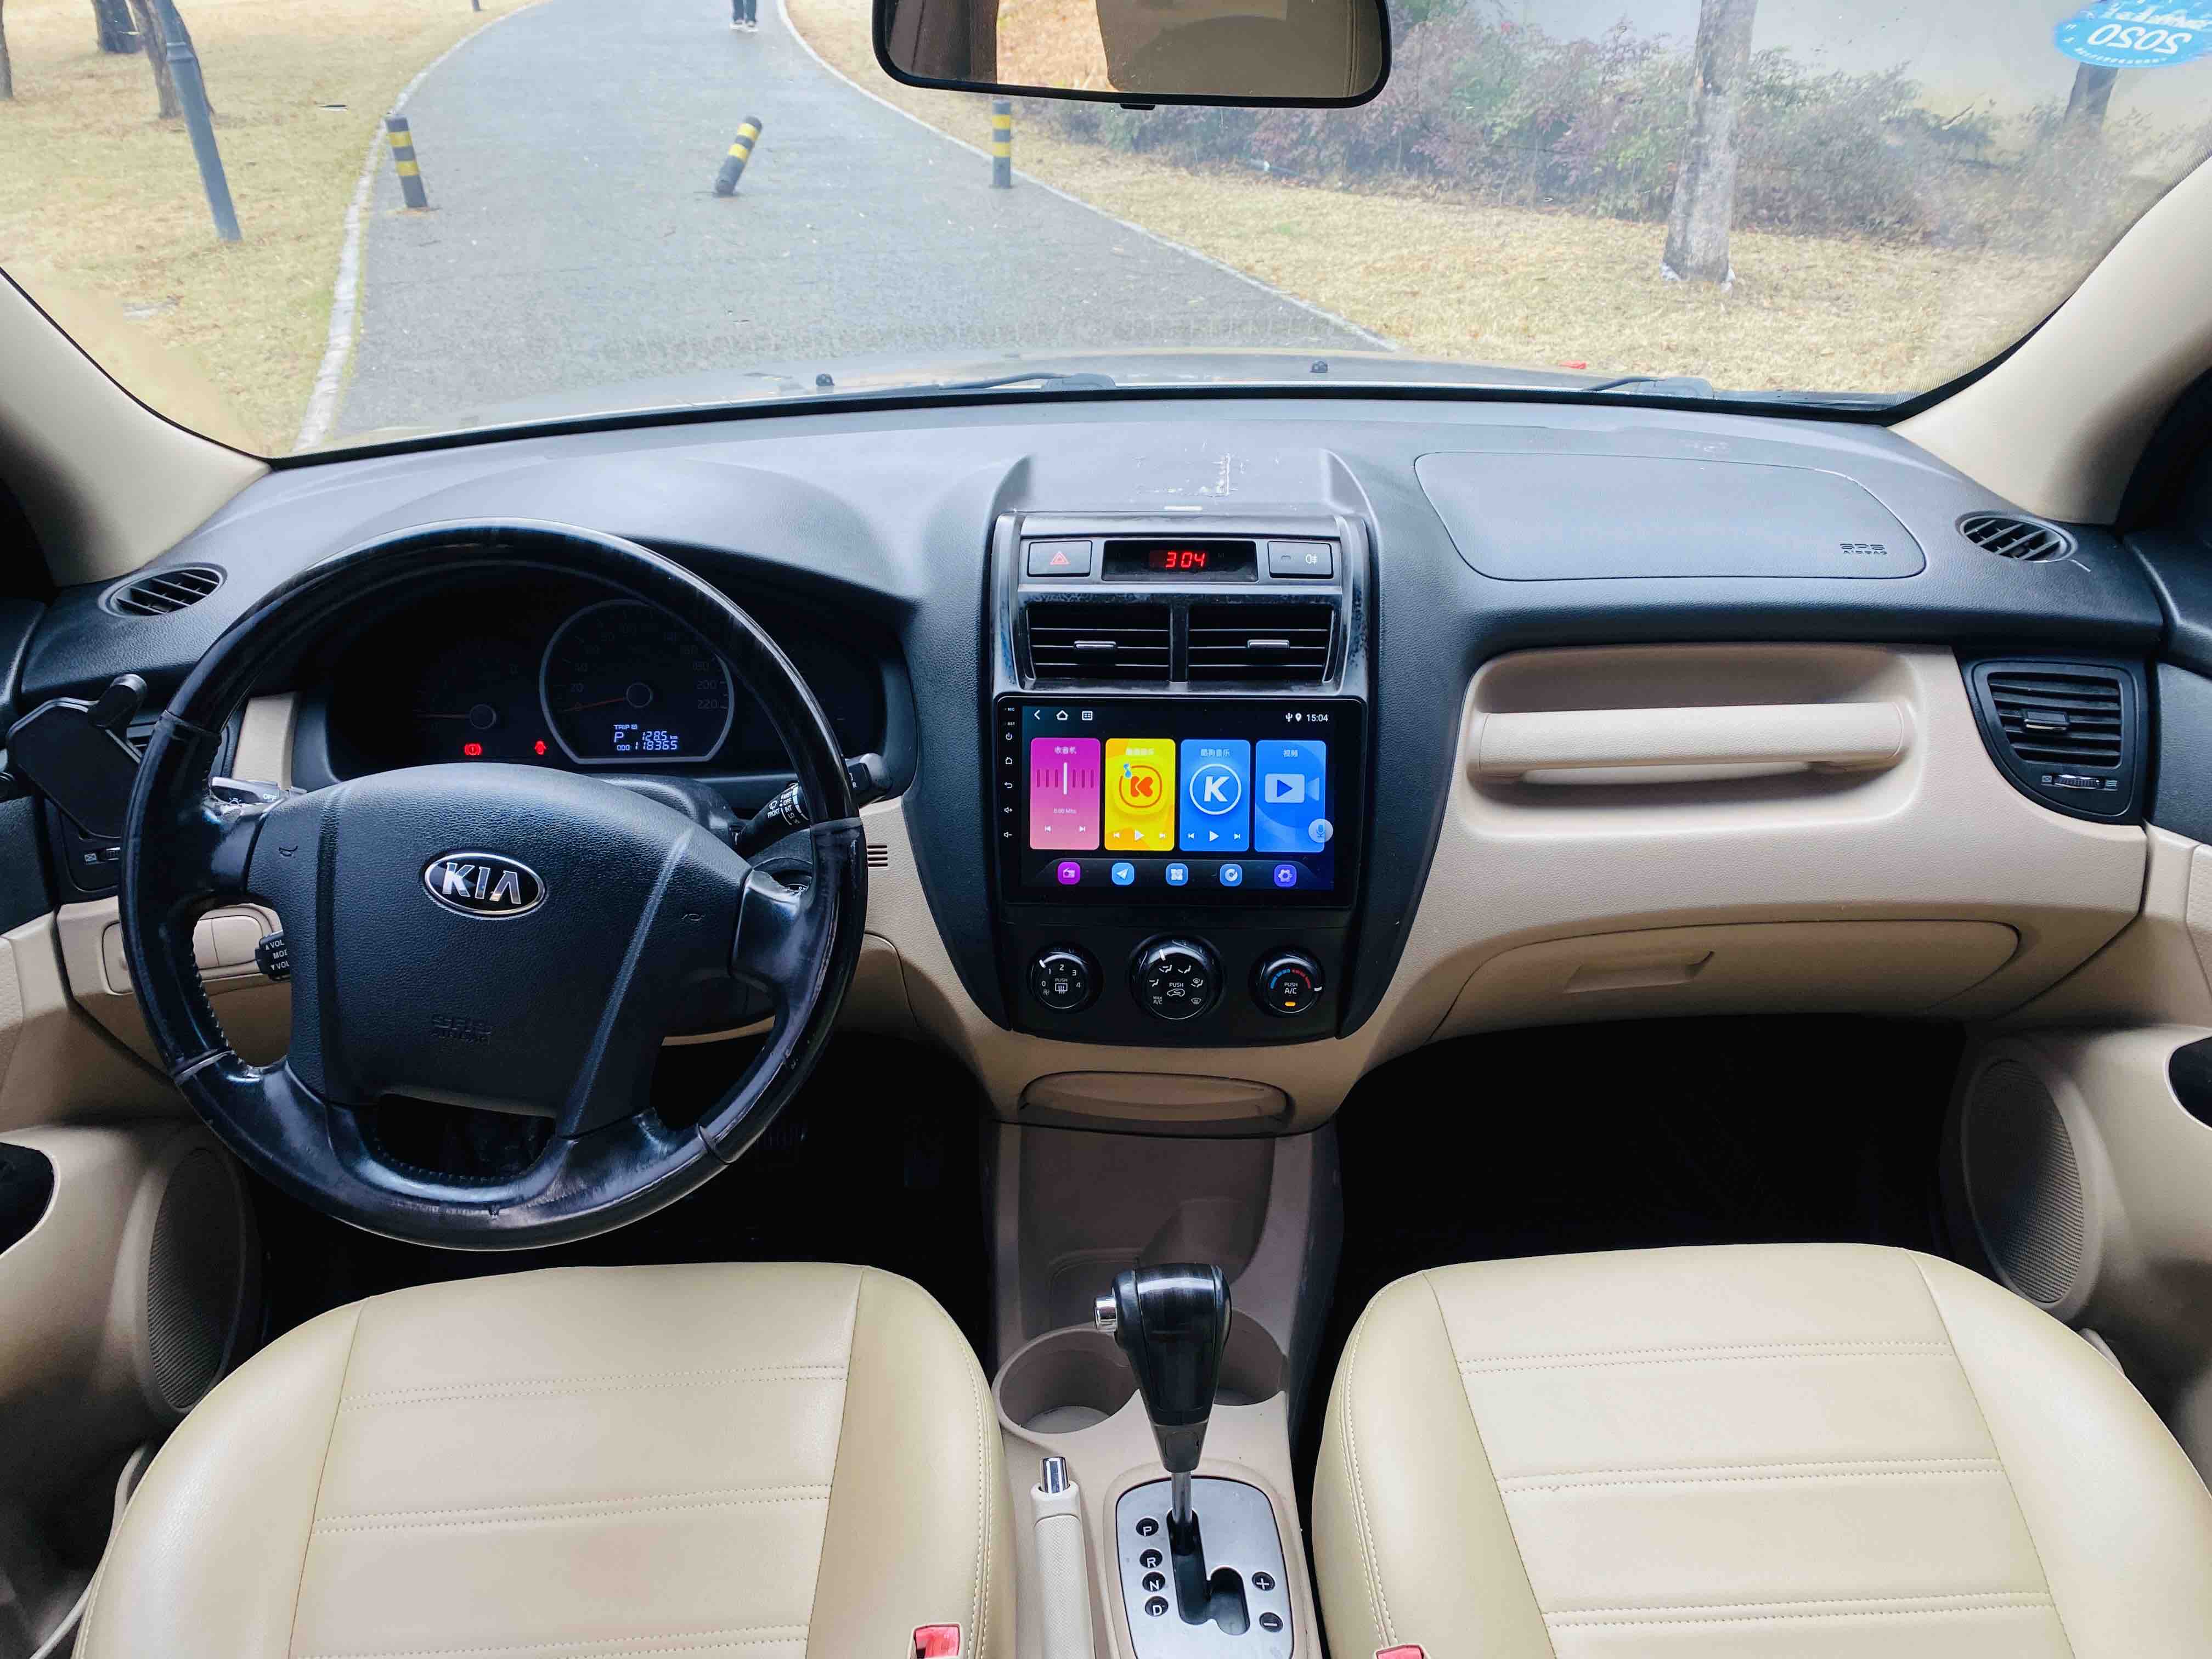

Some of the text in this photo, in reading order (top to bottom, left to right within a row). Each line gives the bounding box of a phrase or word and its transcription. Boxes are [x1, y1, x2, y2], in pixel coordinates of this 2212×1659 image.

[1306, 714, 1328, 722] 15:04
[614, 731, 624, 743] P
[635, 741, 678, 750] 118365
[442, 861, 521, 905] KIA
[269, 939, 285, 949] VOL
[1143, 1526, 1152, 1537] P
[1147, 1556, 1156, 1568] R
[1149, 1579, 1160, 1591] N
[1152, 1605, 1163, 1616] D
